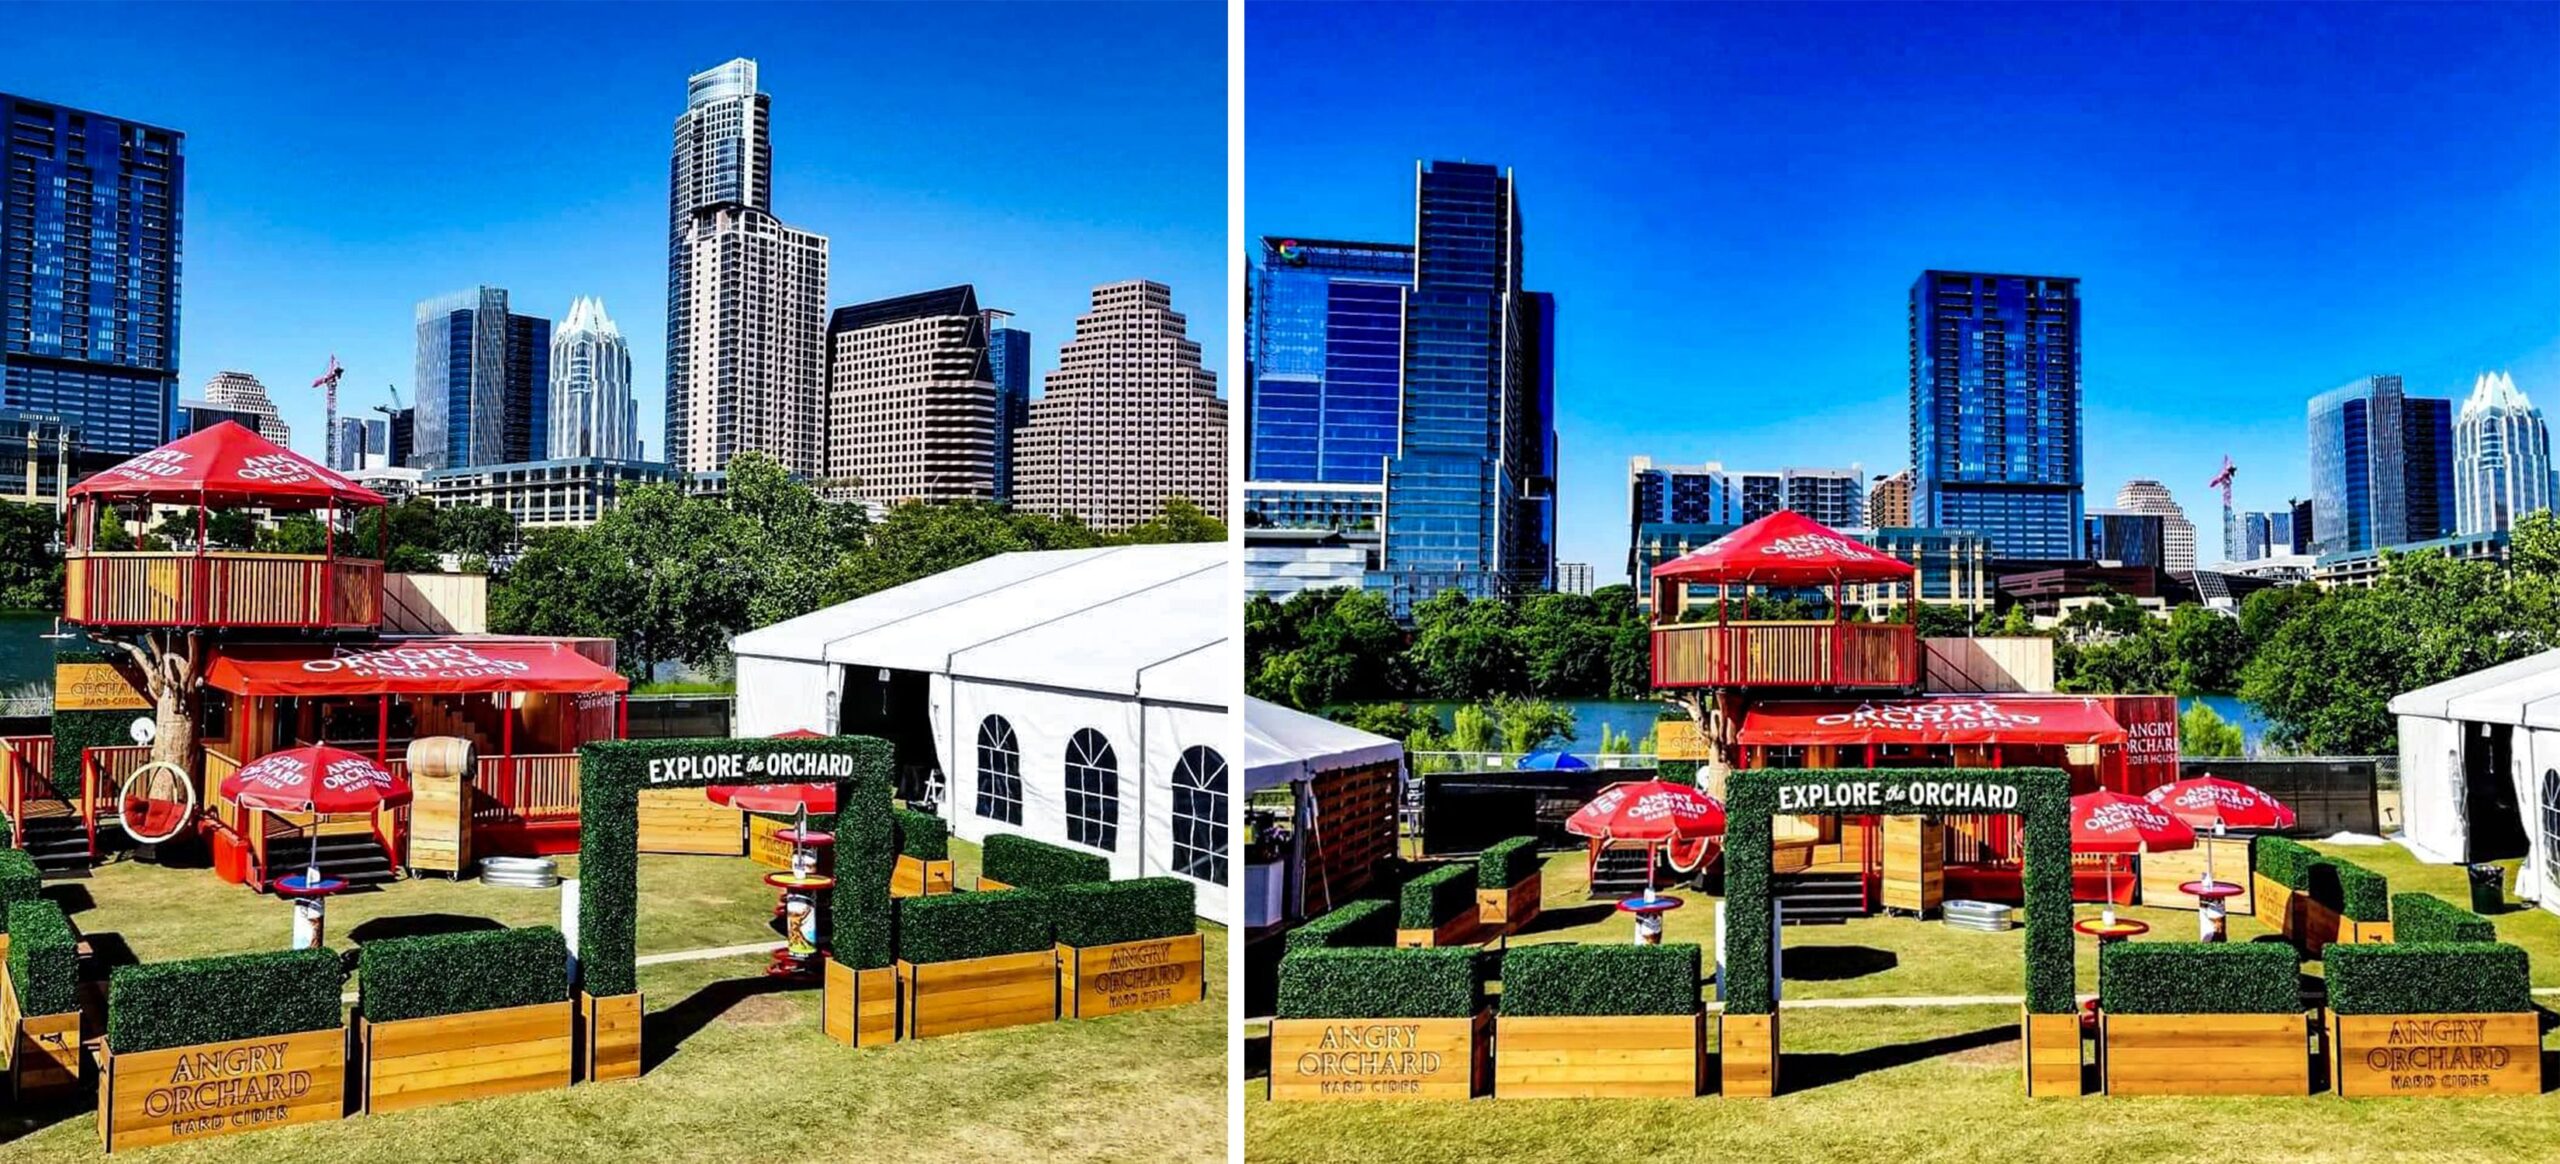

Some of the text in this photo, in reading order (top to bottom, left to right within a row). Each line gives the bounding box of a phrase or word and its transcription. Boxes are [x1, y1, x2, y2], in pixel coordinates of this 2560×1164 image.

[270, 473, 310, 484] HARD
[333, 643, 477, 660] ANGRY
[83, 666, 121, 682] ANG
[302, 656, 530, 673] ORCHARD
[354, 666, 516, 679] HARD CIDER
[71, 682, 138, 698] ORCHA
[1852, 699, 2000, 716] ANGRY
[1816, 711, 2041, 726] ORCHARD
[1853, 720, 2014, 730] HARD CIDER
[2128, 721, 2173, 738] ANGRY
[649, 752, 854, 784] EXPLORE the ORCHARD
[1778, 781, 2018, 810] EXPLORE the ORCHARD
[1109, 942, 1172, 972] ANGRY
[1094, 963, 1186, 996] ORCHARD
[1319, 1024, 1421, 1050] ANGRY
[2387, 1018, 2488, 1045] ANGRY
[170, 1041, 289, 1085] ANGRY
[1297, 1050, 1442, 1077] ORCHARD
[2366, 1044, 2512, 1073] ORCHARD
[1320, 1078, 1421, 1095] HARD CIDER
[2391, 1072, 2491, 1091] HARD CIDER
[144, 1069, 312, 1119] ORCHARD
[171, 1103, 289, 1137] HARD CIDER
